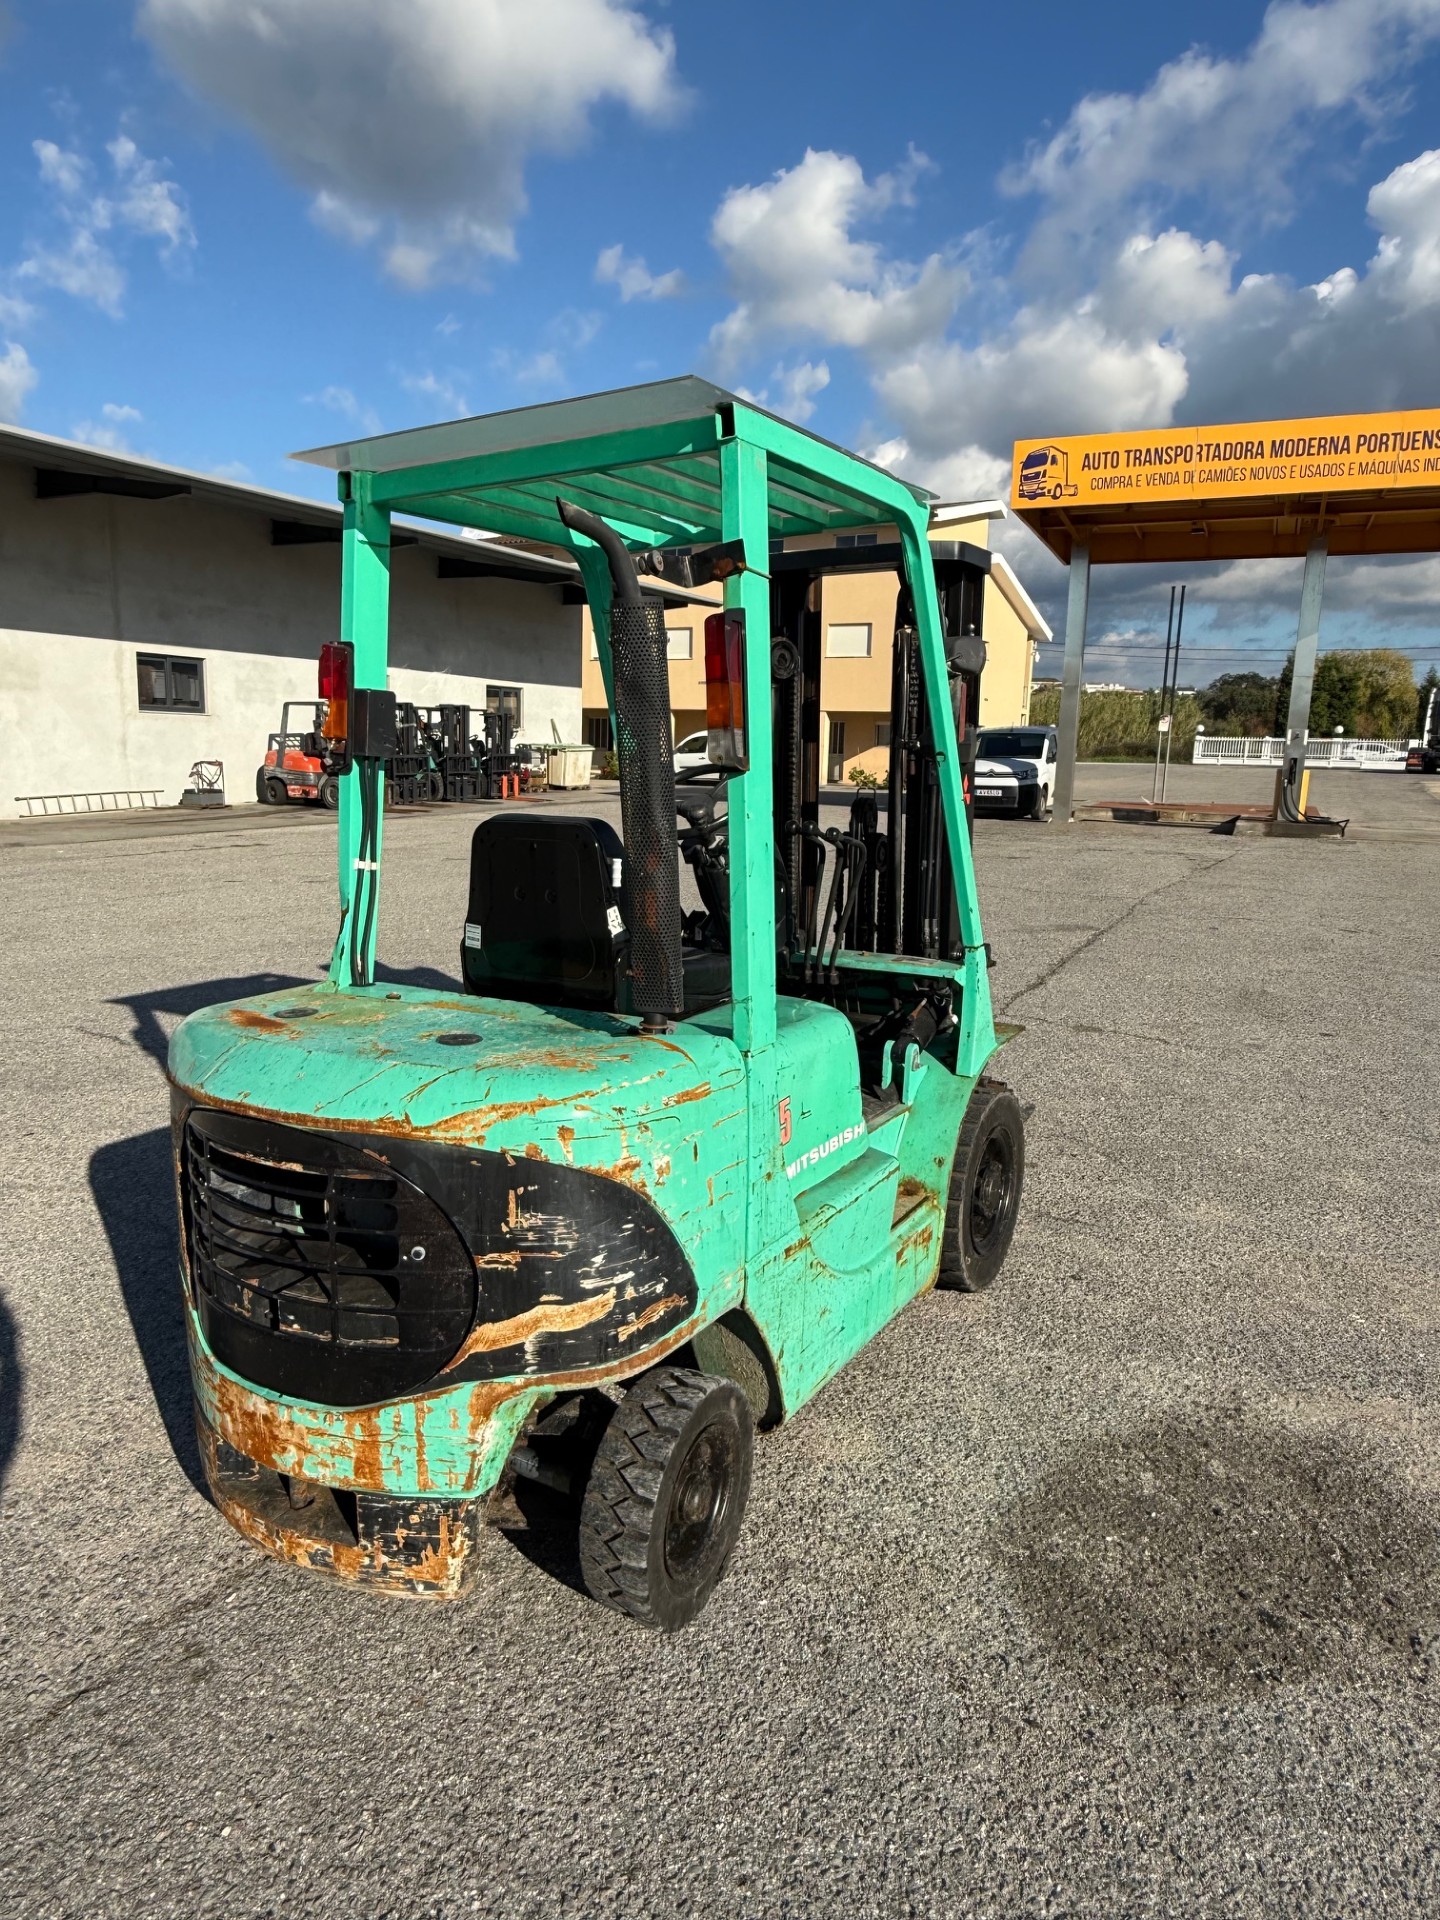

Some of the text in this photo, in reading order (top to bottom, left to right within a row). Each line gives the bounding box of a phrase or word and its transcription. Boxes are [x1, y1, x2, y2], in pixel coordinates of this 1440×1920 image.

[1081, 450, 1120, 471] AUTO
[1124, 440, 1265, 468] TRANSPORTADORA
[1270, 435, 1351, 458] MODERNA
[1090, 475, 1133, 490] COMPRA
[1135, 474, 1143, 487] E
[1145, 471, 1180, 486] VENDA
[1199, 466, 1247, 483] CAMIÕES
[1249, 465, 1287, 481] NOVOS
[1289, 464, 1297, 479] E
[1299, 462, 1345, 478] USADOS
[1348, 461, 1356, 476] E
[1358, 458, 1421, 475] MÁQUINAS
